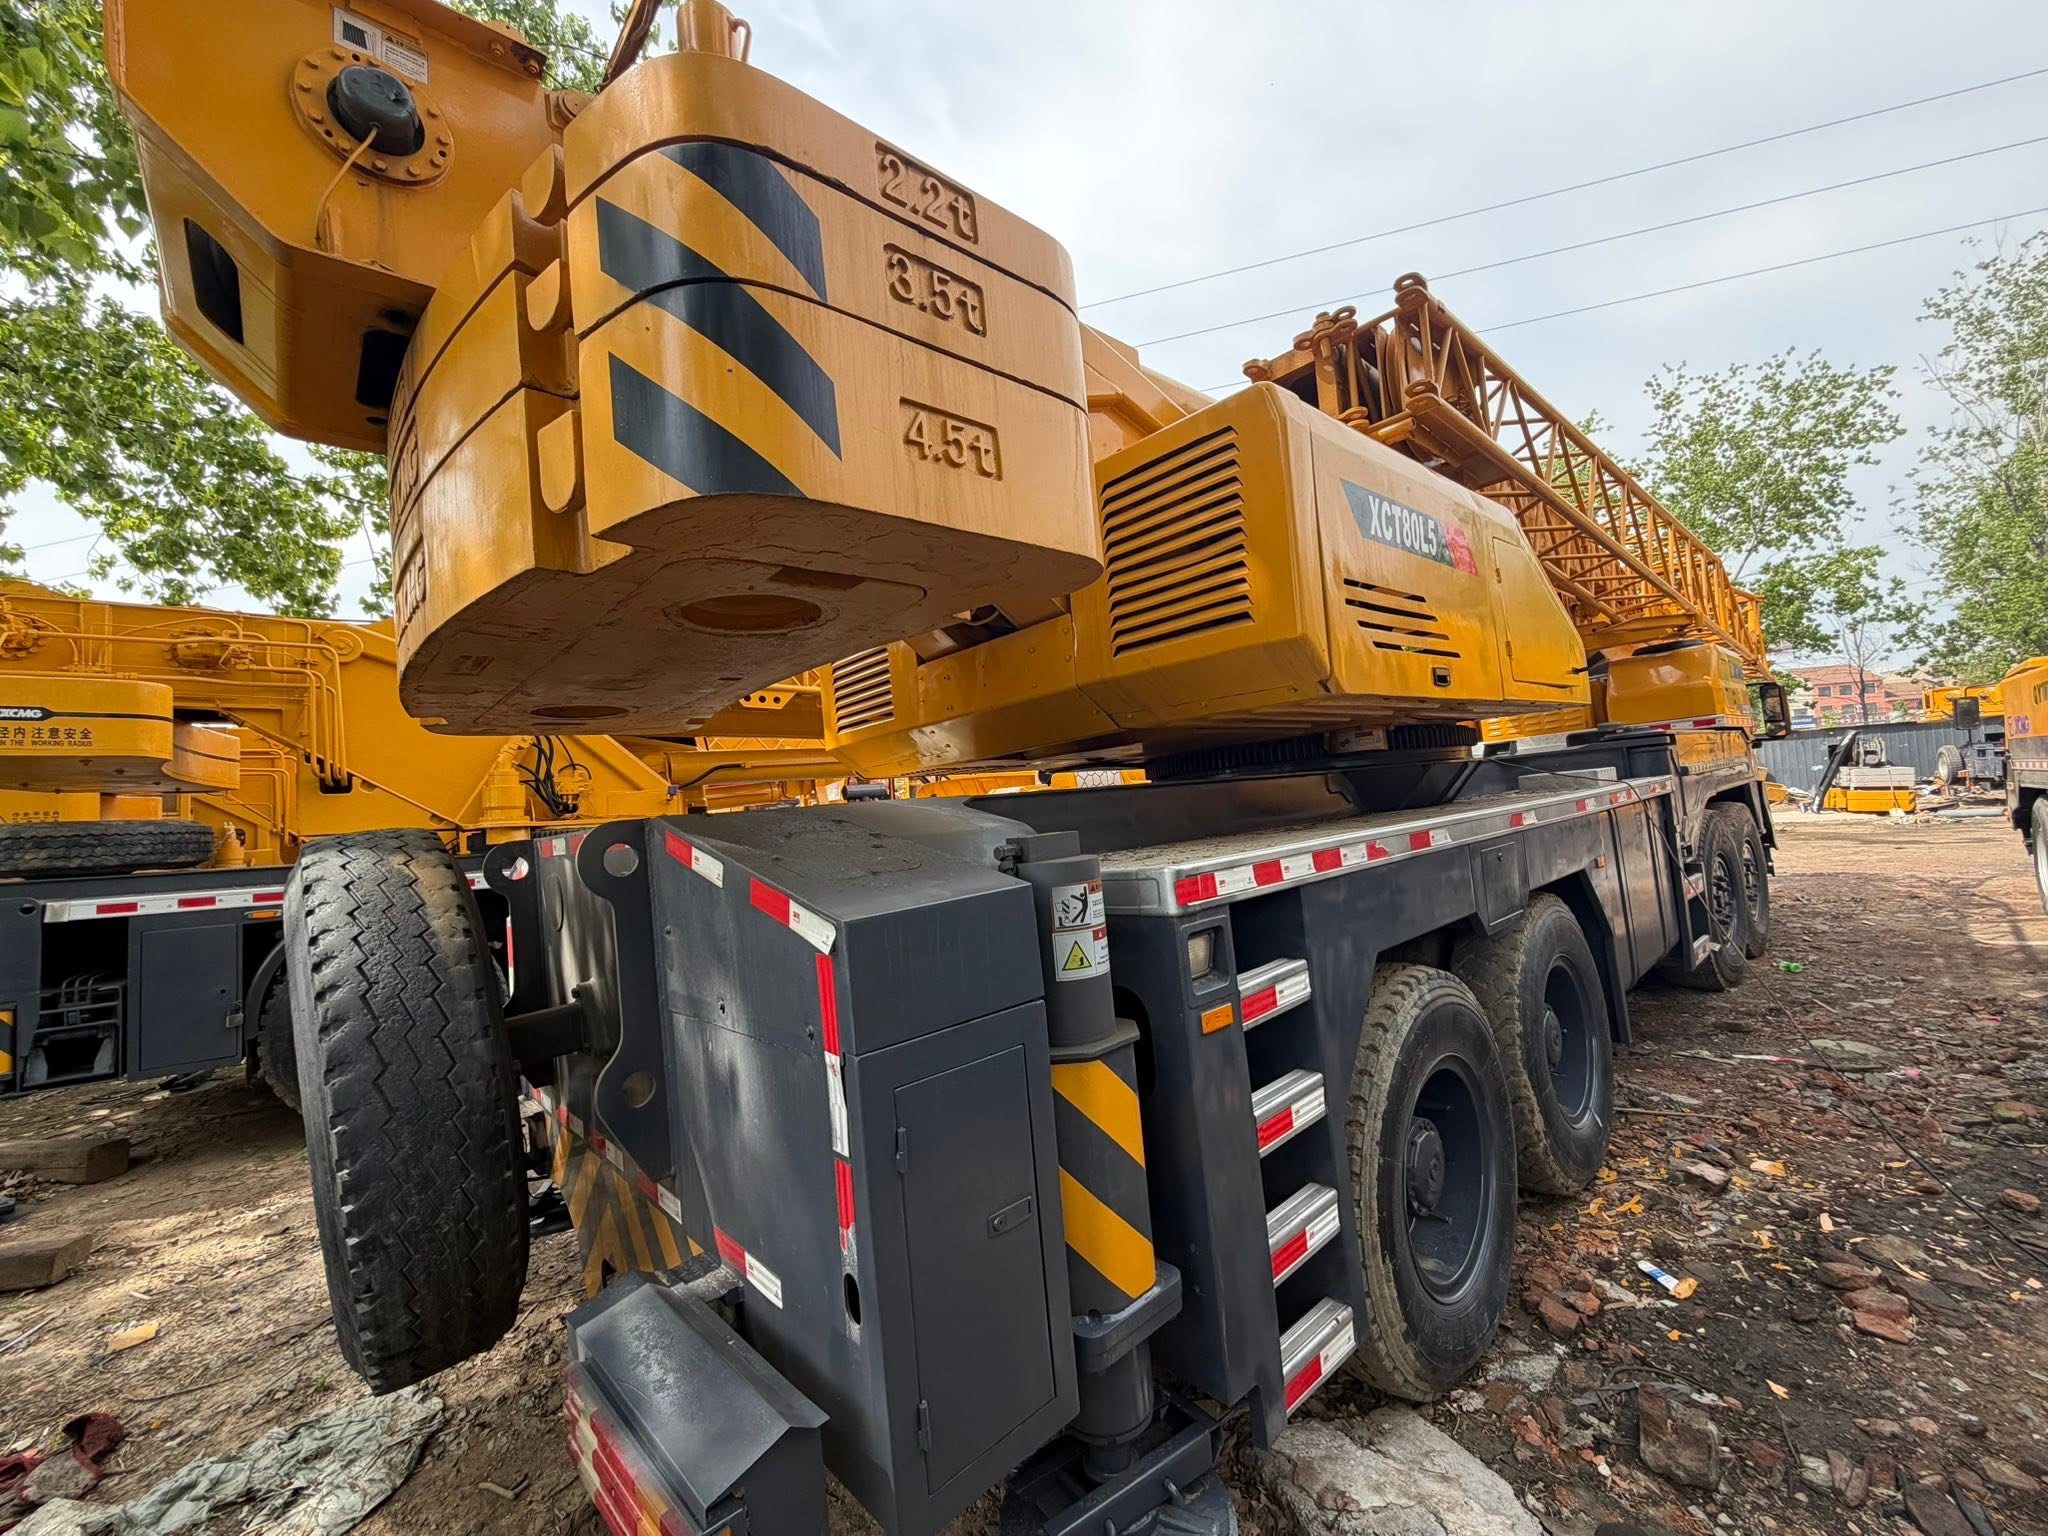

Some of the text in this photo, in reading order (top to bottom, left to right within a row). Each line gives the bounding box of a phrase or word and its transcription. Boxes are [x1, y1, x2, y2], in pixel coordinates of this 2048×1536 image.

[879, 153, 974, 241] 2.2t
[889, 252, 983, 333] 3.5t
[903, 411, 996, 478] 4.5t
[1368, 495, 1437, 556] XCT80L5
